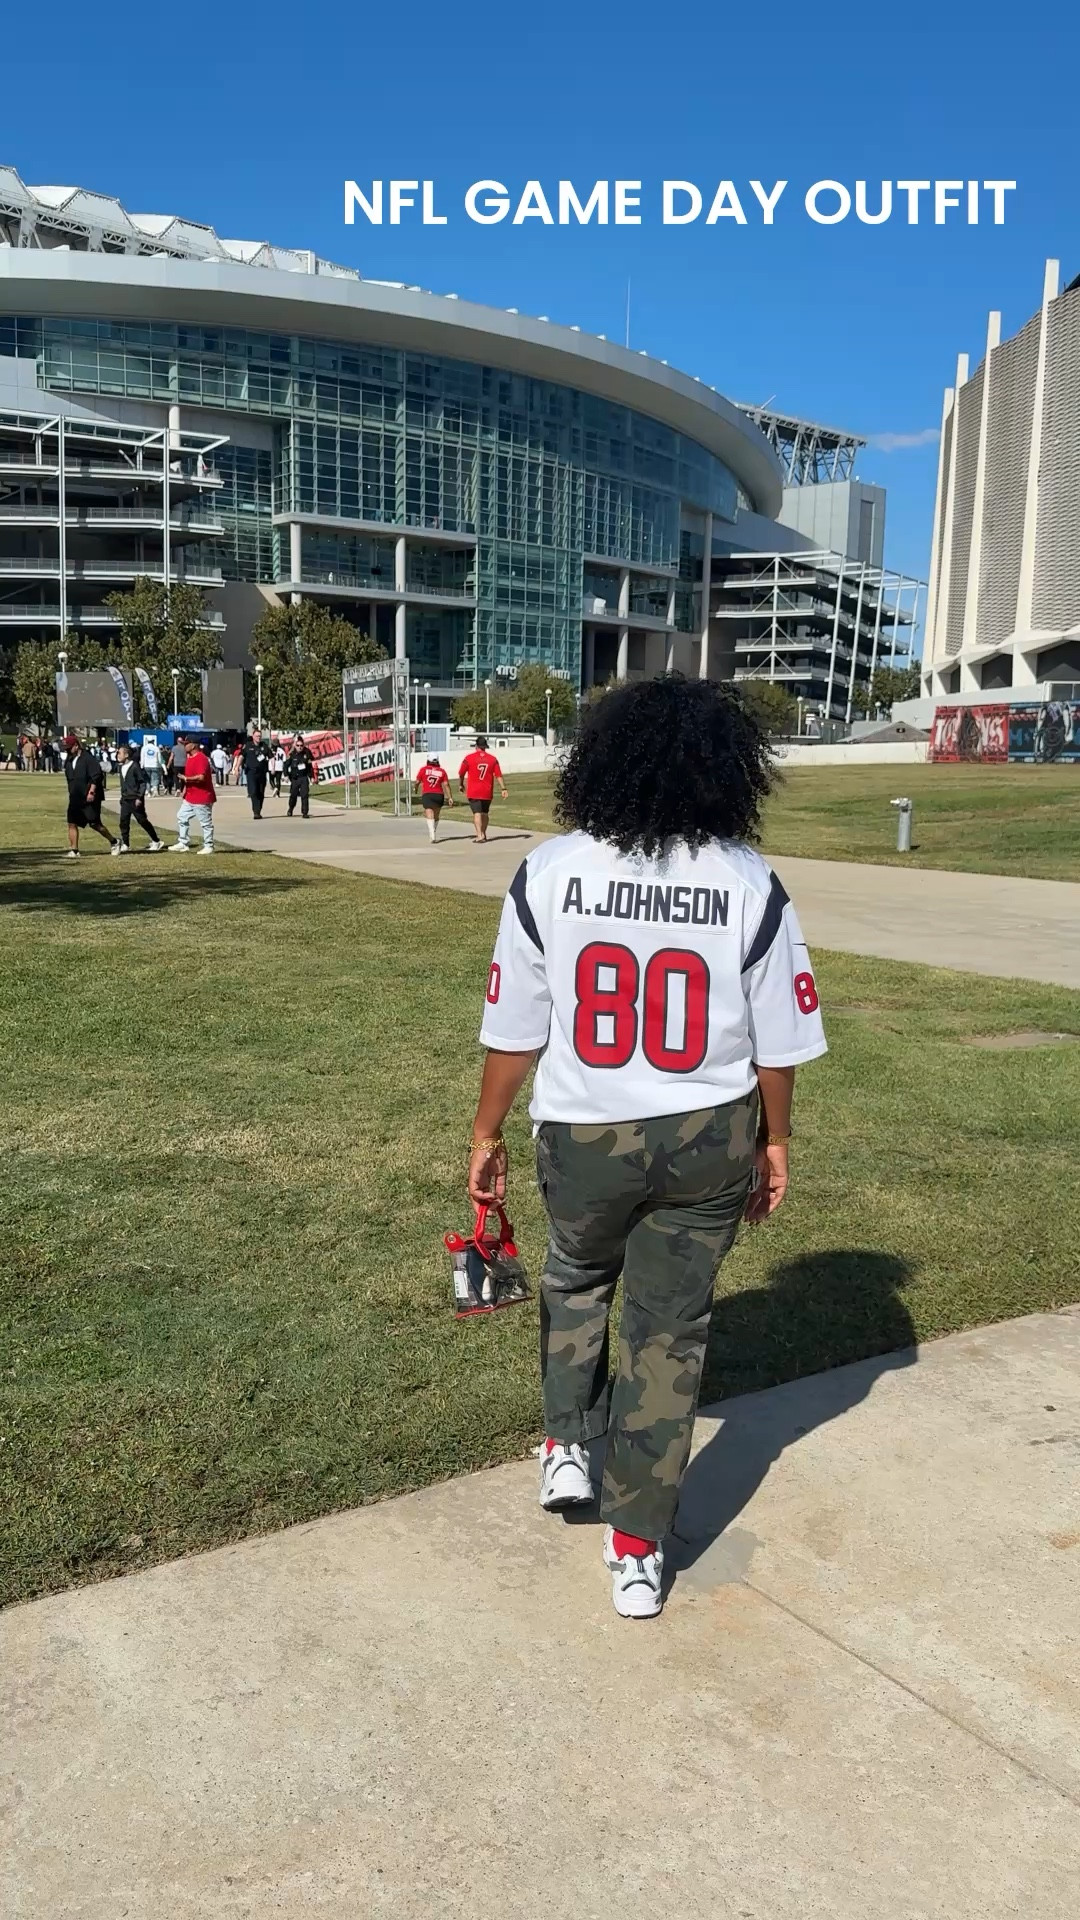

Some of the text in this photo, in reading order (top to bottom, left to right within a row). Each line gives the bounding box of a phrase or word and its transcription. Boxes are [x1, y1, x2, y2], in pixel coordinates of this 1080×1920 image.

[496, 664, 518, 681] nrg
[318, 761, 350, 782] STON
[352, 748, 395, 771] EXAN
[477, 763, 488, 781] 7
[562, 877, 729, 927] A.JOHNSON
[572, 940, 711, 1075] 80
[794, 971, 819, 1015] 8
